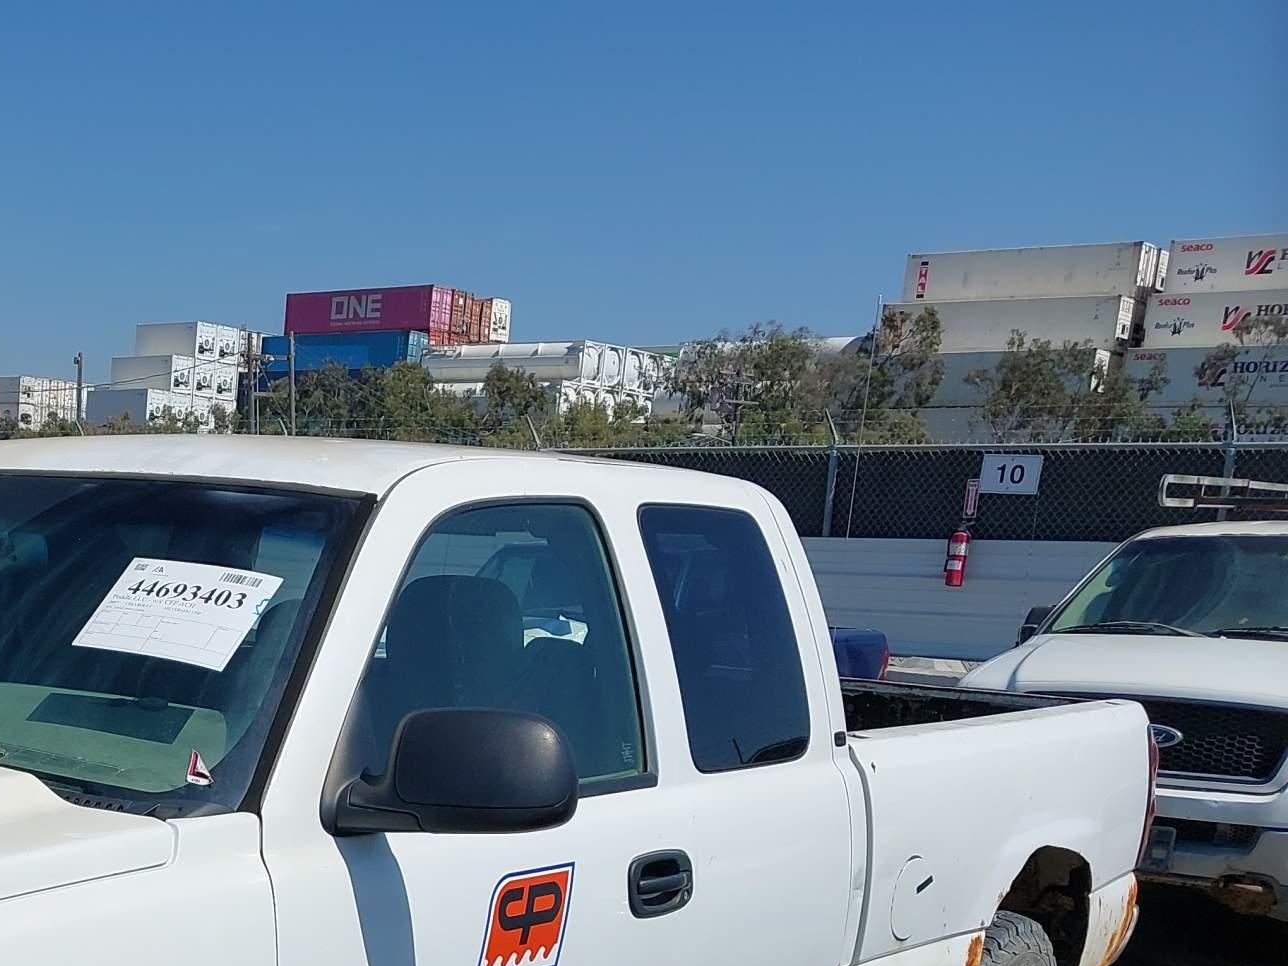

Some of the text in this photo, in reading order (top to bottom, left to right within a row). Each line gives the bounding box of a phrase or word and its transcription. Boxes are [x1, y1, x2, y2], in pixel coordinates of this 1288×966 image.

[1181, 244, 1214, 252] seaco
[331, 294, 383, 320] ONE
[1158, 298, 1191, 306] seaco
[997, 464, 1025, 484] 10
[127, 579, 248, 609] 44693403
